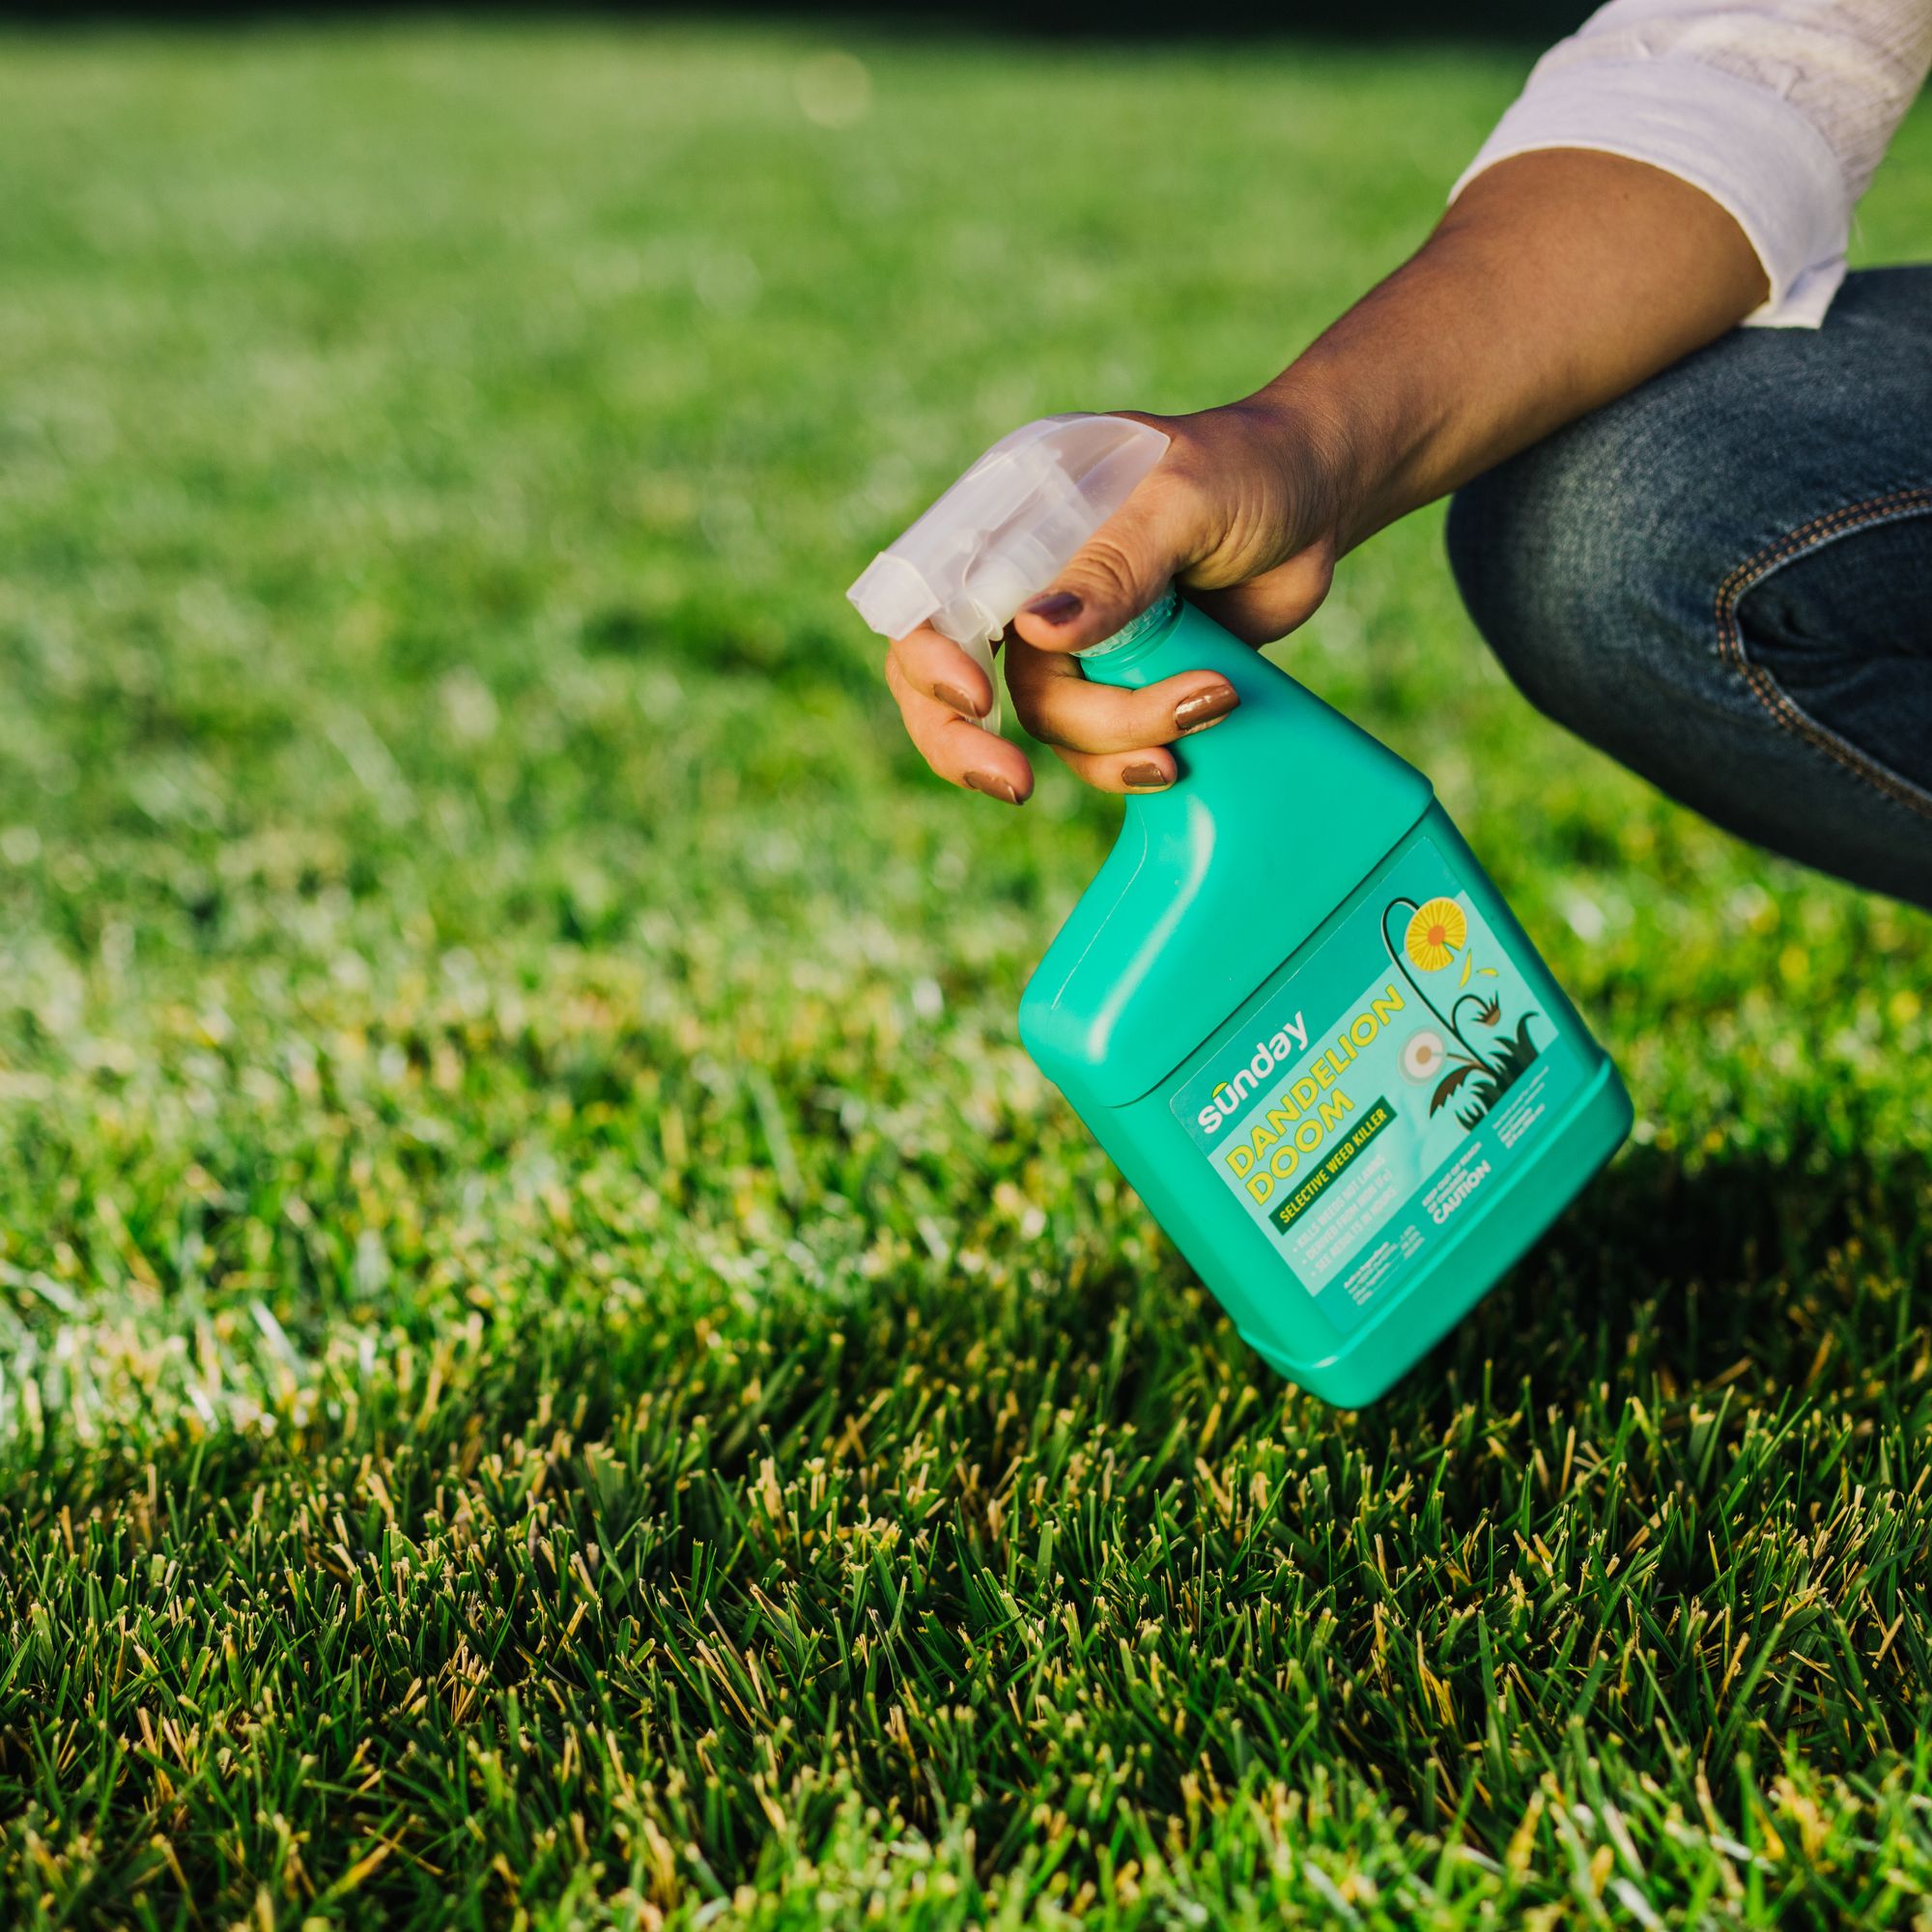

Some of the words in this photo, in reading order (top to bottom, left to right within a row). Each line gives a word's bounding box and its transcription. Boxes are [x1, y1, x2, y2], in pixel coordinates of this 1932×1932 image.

[1198, 1011, 1308, 1133] sunday
[1226, 984, 1405, 1179] DANDELION
[1245, 1089, 1354, 1205] DOOM
[1279, 1169, 1329, 1223] SELECTIVE
[1325, 1142, 1355, 1174] WEED
[1351, 1107, 1387, 1147] KILLER
[1433, 1159, 1491, 1224] CAUTION
[1295, 1221, 1321, 1249] KILLS
[1317, 1196, 1346, 1230] WEEDS
[1335, 1203, 1359, 1230] FROM
[1314, 1252, 1332, 1272] SEE
